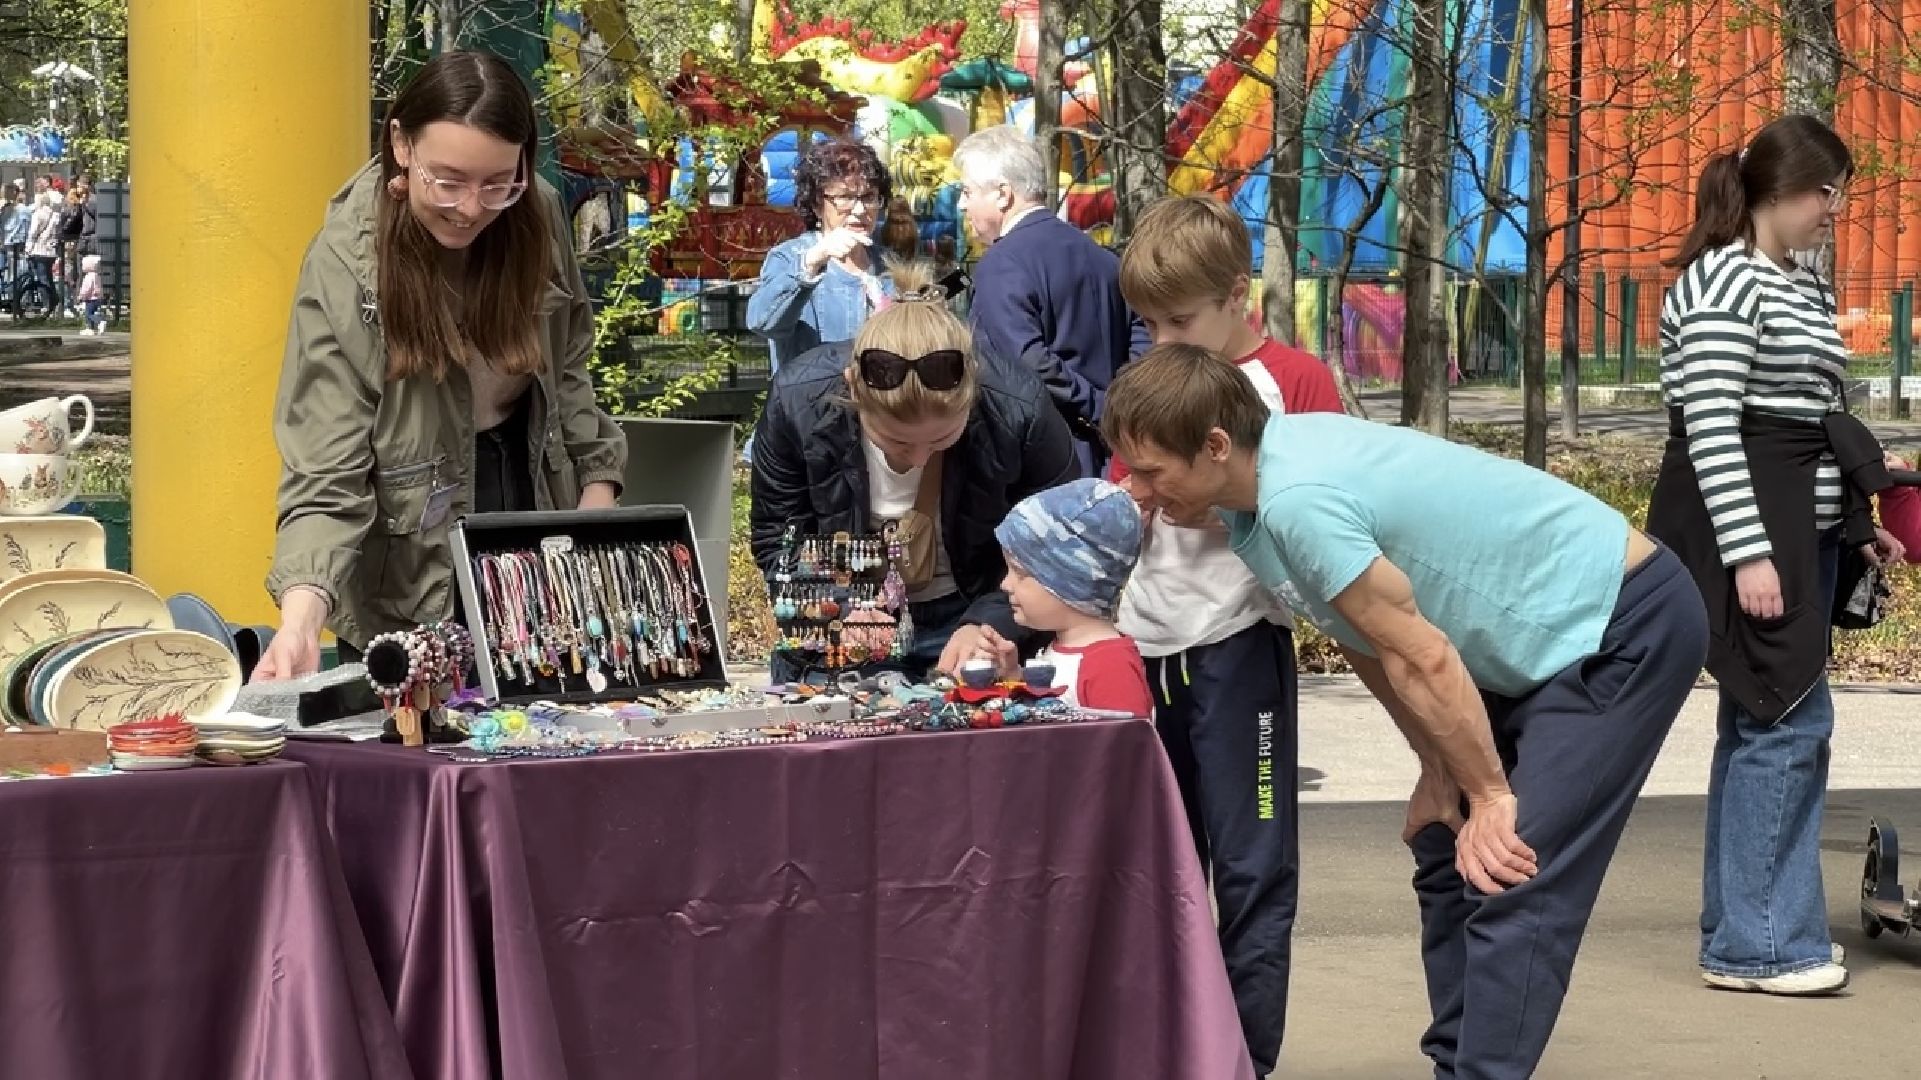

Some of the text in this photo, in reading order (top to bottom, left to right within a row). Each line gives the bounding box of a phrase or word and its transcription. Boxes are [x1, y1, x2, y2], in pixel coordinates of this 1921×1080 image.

[1258, 711, 1274, 819] MAKE THE FUTURE
